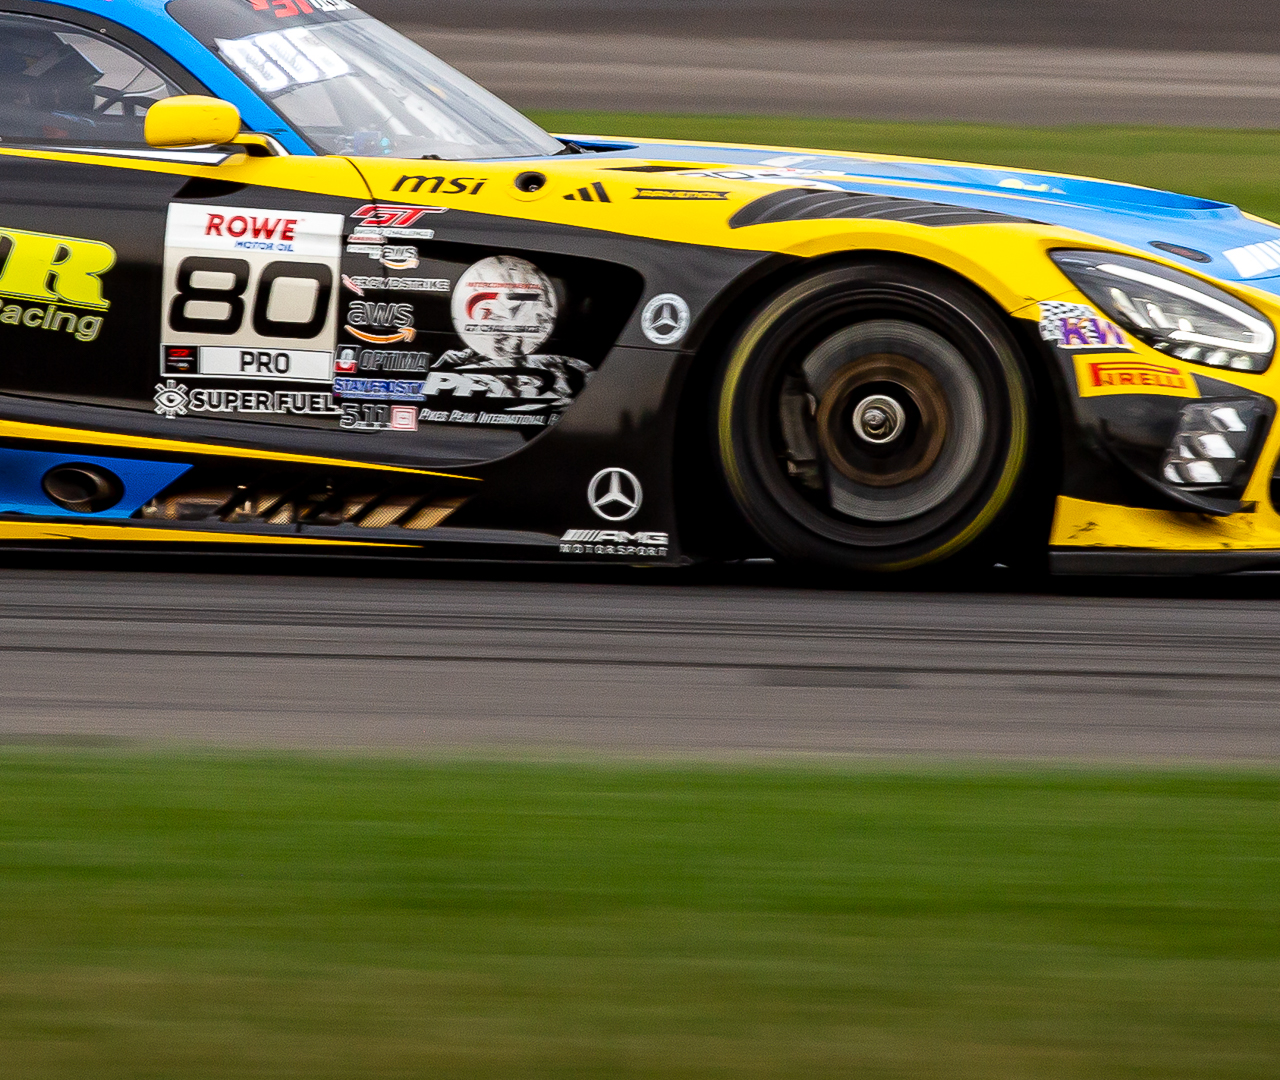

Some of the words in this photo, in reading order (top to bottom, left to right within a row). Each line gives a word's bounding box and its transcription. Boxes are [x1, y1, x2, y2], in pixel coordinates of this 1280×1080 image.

[204, 213, 298, 241] ROWE
[234, 240, 274, 251] MOTOR
[276, 242, 295, 252] OIL
[168, 255, 333, 340] 80
[347, 301, 415, 327] aws
[239, 350, 291, 374] PRO
[1088, 361, 1188, 389] PIRELLI
[190, 389, 272, 413] SUPER
[274, 391, 340, 414] FUEL
